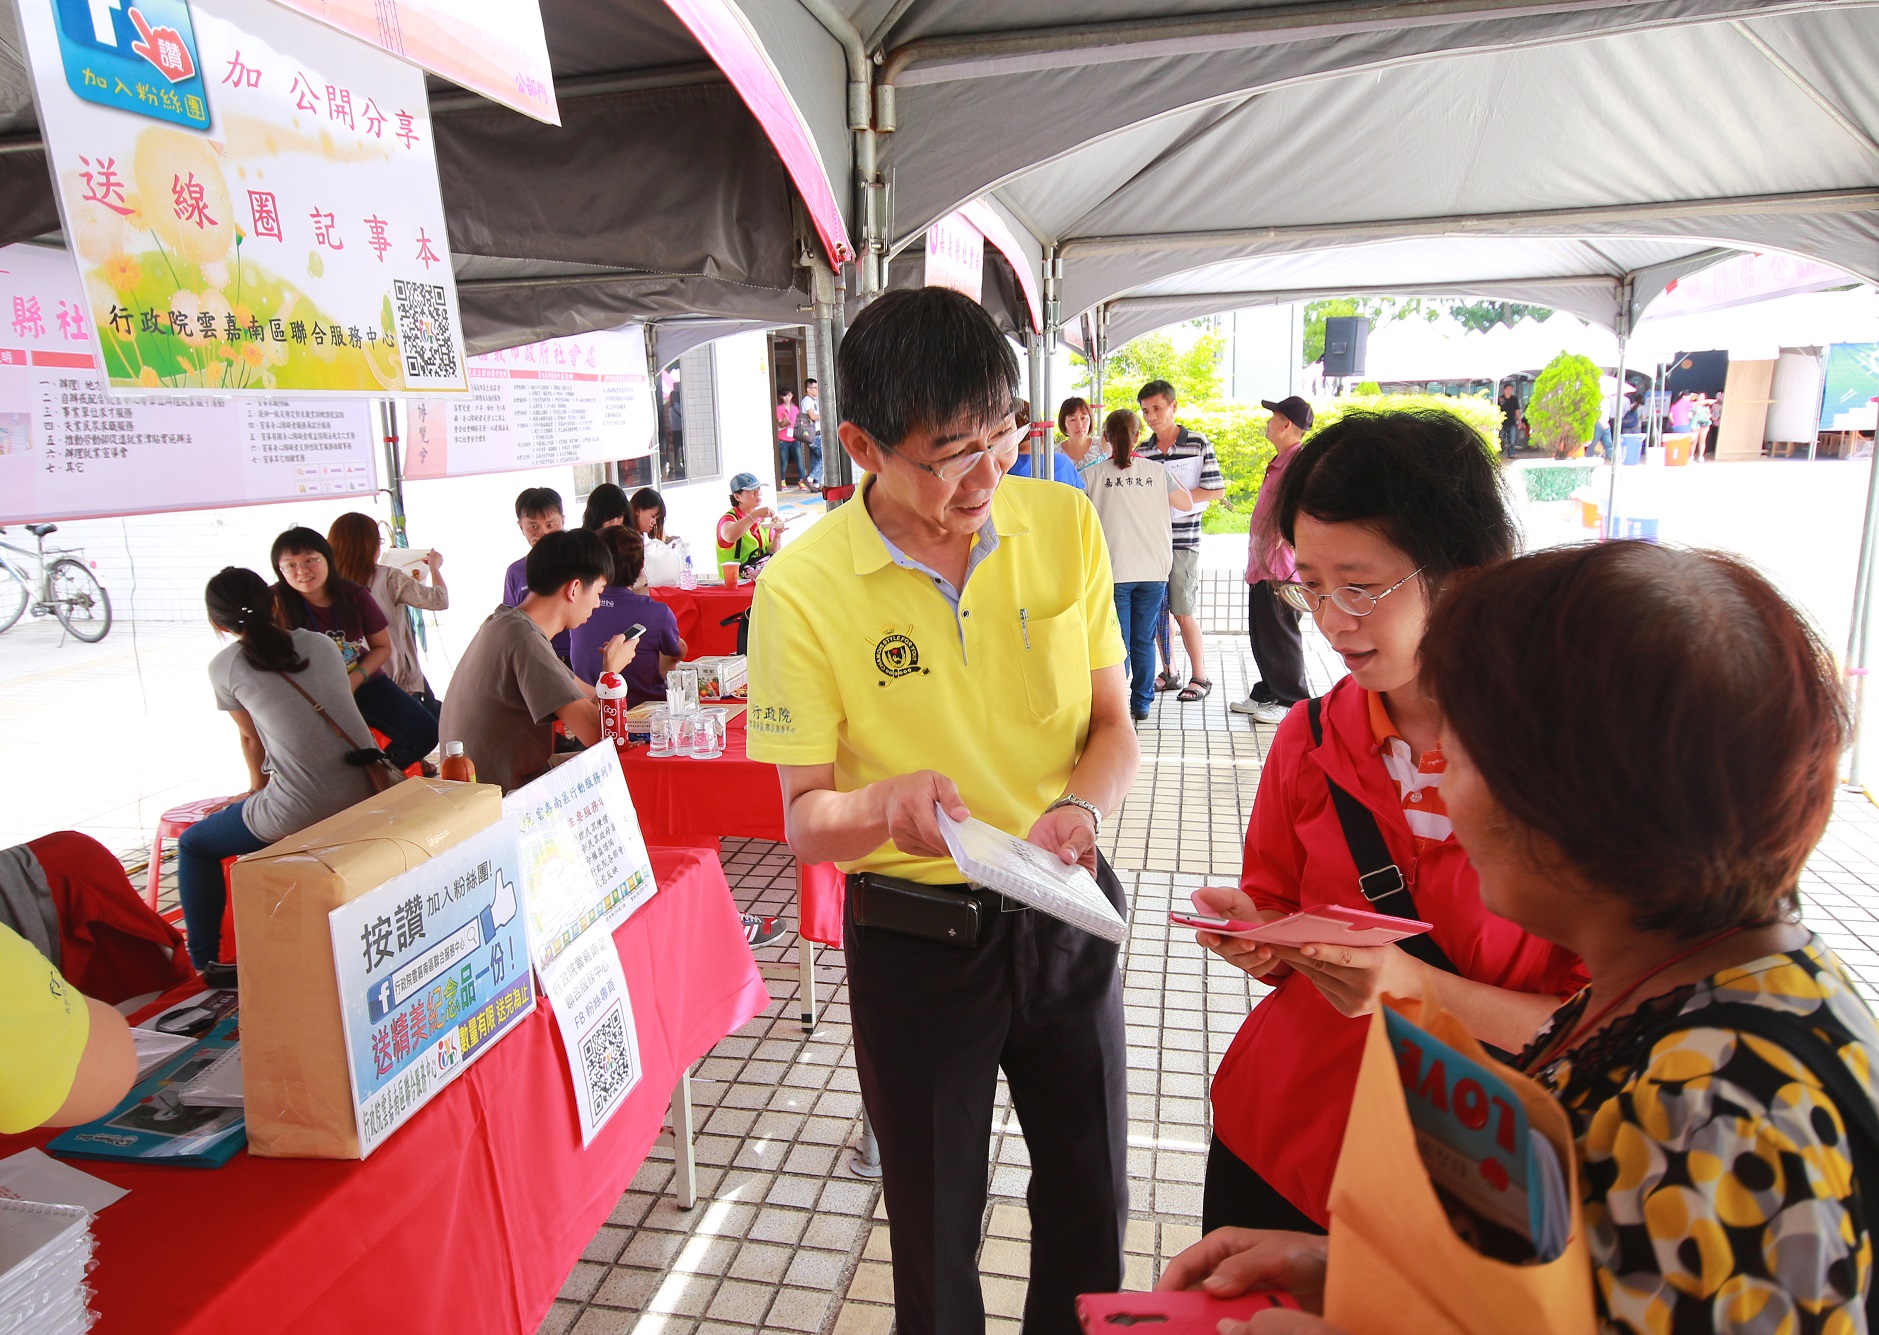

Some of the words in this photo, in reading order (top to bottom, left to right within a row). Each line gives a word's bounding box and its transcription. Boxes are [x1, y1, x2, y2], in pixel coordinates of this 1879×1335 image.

[158, 38, 184, 72] 讚
[82, 67, 206, 121] 加入粉絲團
[222, 50, 262, 88] 加
[290, 71, 420, 150] 公開分享
[515, 71, 548, 105] 公部門
[78, 155, 441, 270] 送線圈記事本
[109, 304, 396, 350] 行政院雲嘉南區聯合服務中心
[1104, 477, 1153, 488] 嘉義市政府
[752, 705, 792, 723] 行政院
[361, 893, 426, 975] 按讚
[427, 859, 492, 918] 加入粉絲團!
[395, 938, 465, 996] 行政院雲嘉南區聯合服務中心
[552, 936, 608, 998] 行政院雲嘉南區
[564, 960, 610, 1010] 聯合服務中心
[458, 1004, 497, 1053] 數量有限
[496, 983, 530, 1024] 送完為止
[574, 991, 586, 1030] FB
[585, 977, 616, 1018] 粉絲專頁
[363, 1056, 438, 1144] 行政院雲嘉南區聯合服務中心
